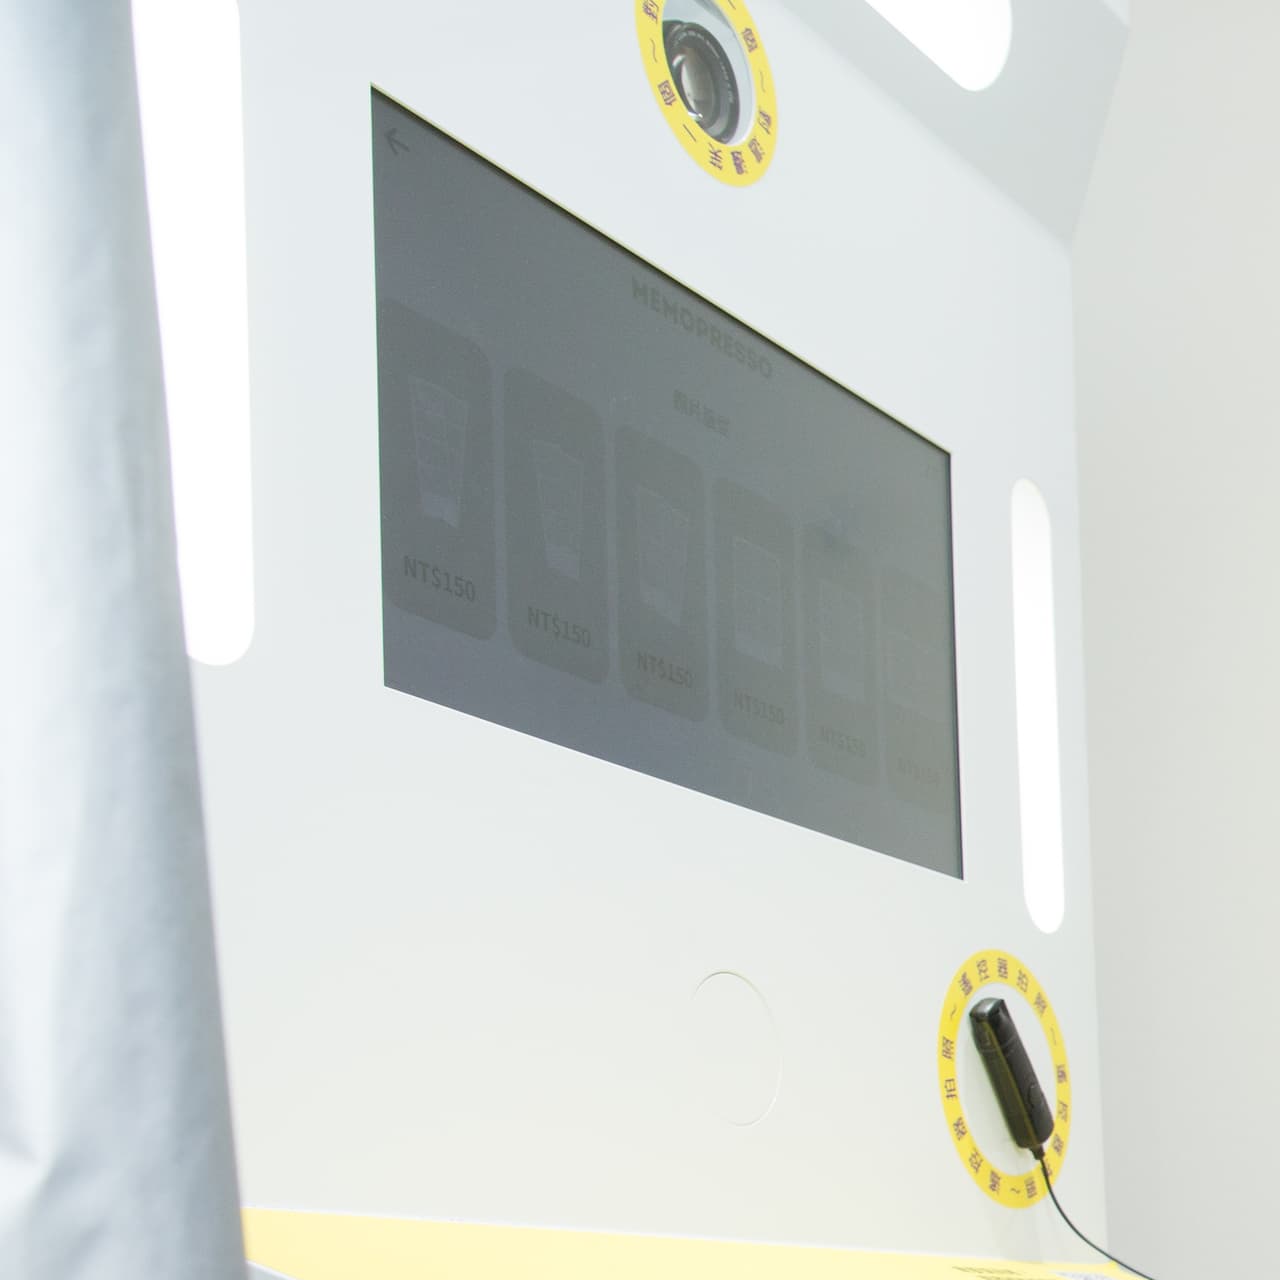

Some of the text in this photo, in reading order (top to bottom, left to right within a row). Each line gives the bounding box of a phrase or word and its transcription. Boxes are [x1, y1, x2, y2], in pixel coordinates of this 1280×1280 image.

[631, 277, 773, 380] MEMOPRESSO
[403, 555, 476, 603] NT$150
[528, 605, 591, 649] NT$150
[637, 651, 693, 690] NT$150
